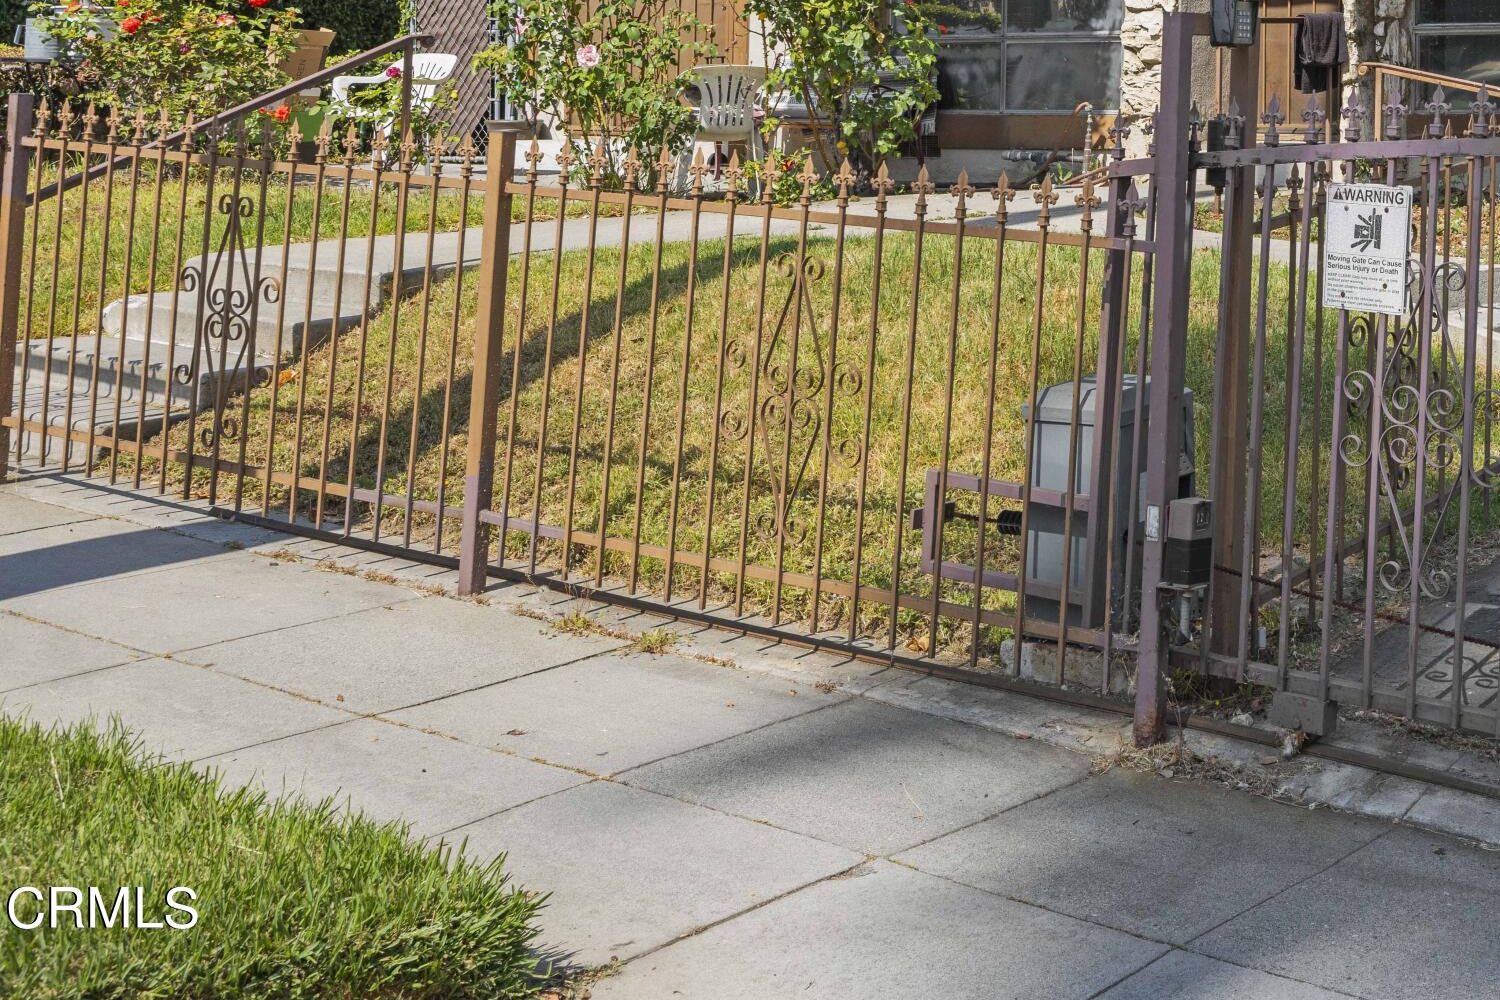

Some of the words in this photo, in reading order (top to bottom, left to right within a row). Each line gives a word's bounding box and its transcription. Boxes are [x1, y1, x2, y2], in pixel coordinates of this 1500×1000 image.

[1344, 187, 1404, 205] WARNING
[1327, 261, 1351, 270] Serious
[1352, 263, 1370, 274] Injury
[1379, 266, 1399, 275] Death
[1328, 254, 1351, 263] Moving
[1351, 256, 1367, 264] Gate
[1367, 258, 1380, 266] Can
[1381, 259, 1402, 268] Cause
